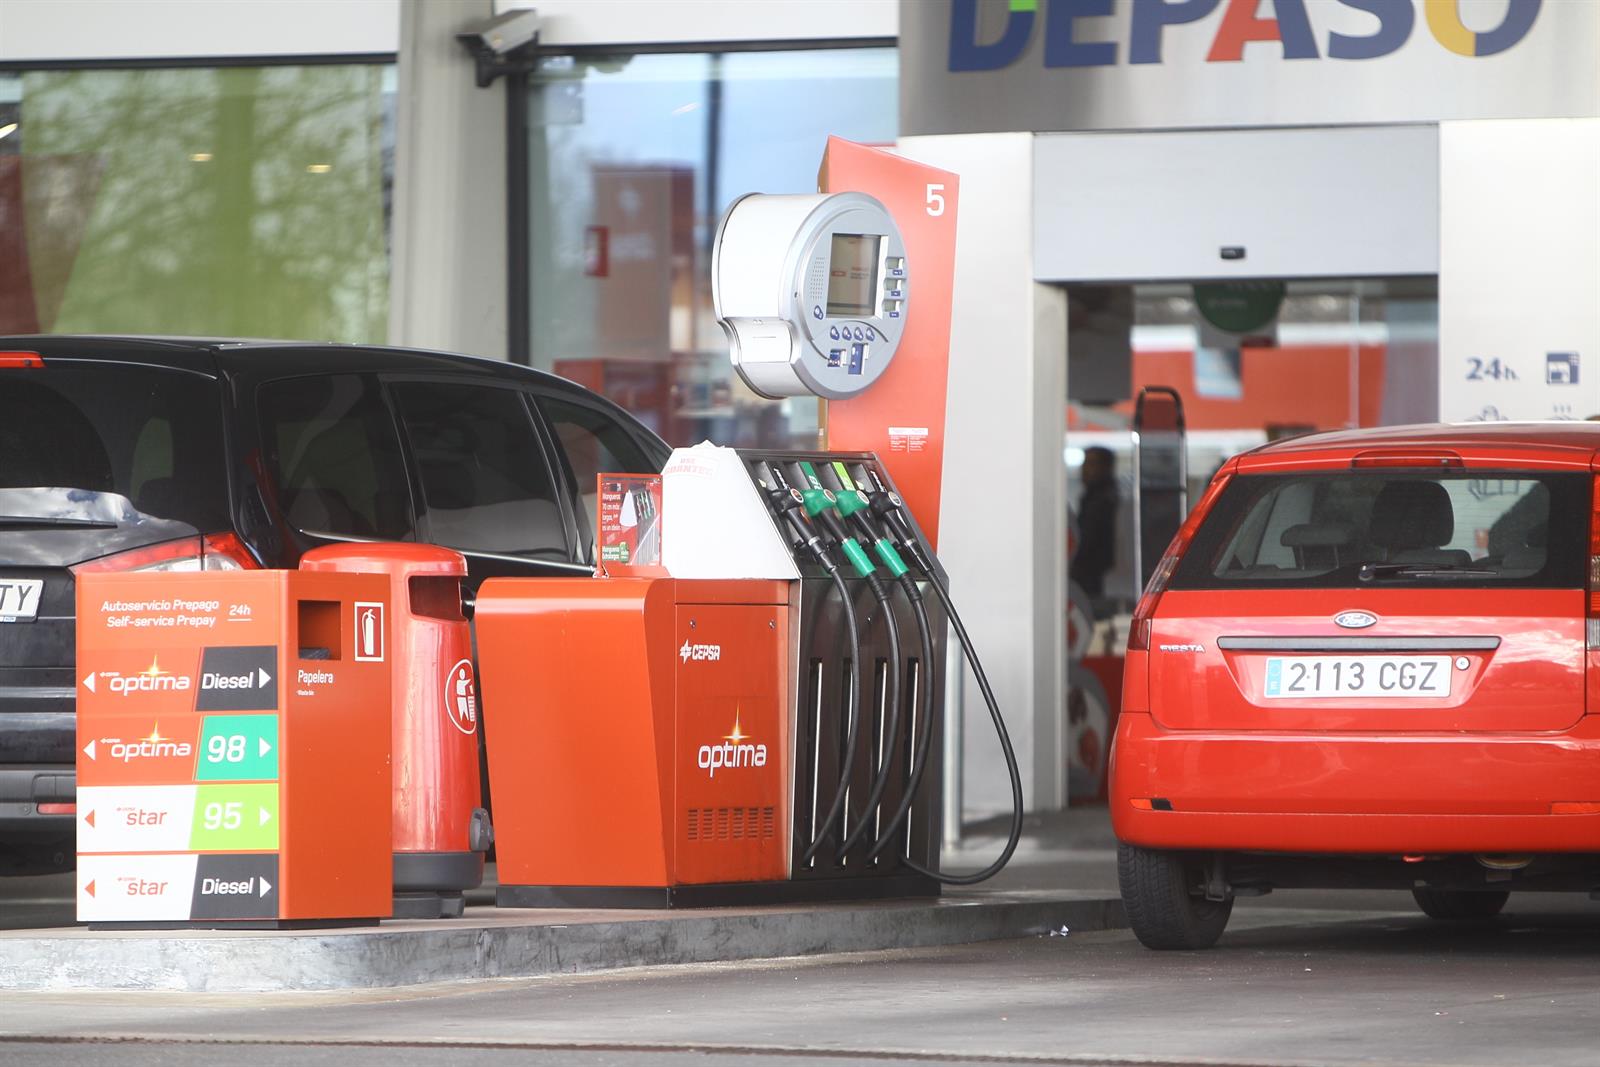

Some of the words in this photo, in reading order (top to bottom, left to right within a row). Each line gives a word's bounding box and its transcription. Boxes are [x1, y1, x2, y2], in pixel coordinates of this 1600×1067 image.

[925, 183, 945, 217] 5
[101, 600, 171, 612] Autoservicio
[172, 599, 220, 612] Prepago
[229, 605, 251, 616] 24h
[107, 615, 175, 628] Self-service
[176, 614, 216, 628] Prepay
[692, 644, 721, 661] CEPSA
[109, 674, 190, 697] optima
[201, 671, 254, 690] Diesel
[298, 669, 334, 686] Papelera
[1288, 662, 1365, 692] 2113
[1379, 661, 1438, 692] CGZ
[111, 740, 192, 763] optima
[207, 735, 247, 763] 98
[698, 741, 767, 778] optima
[126, 809, 167, 825] star
[203, 802, 242, 830] 95
[127, 879, 168, 896] star
[201, 877, 254, 895] Diesel
